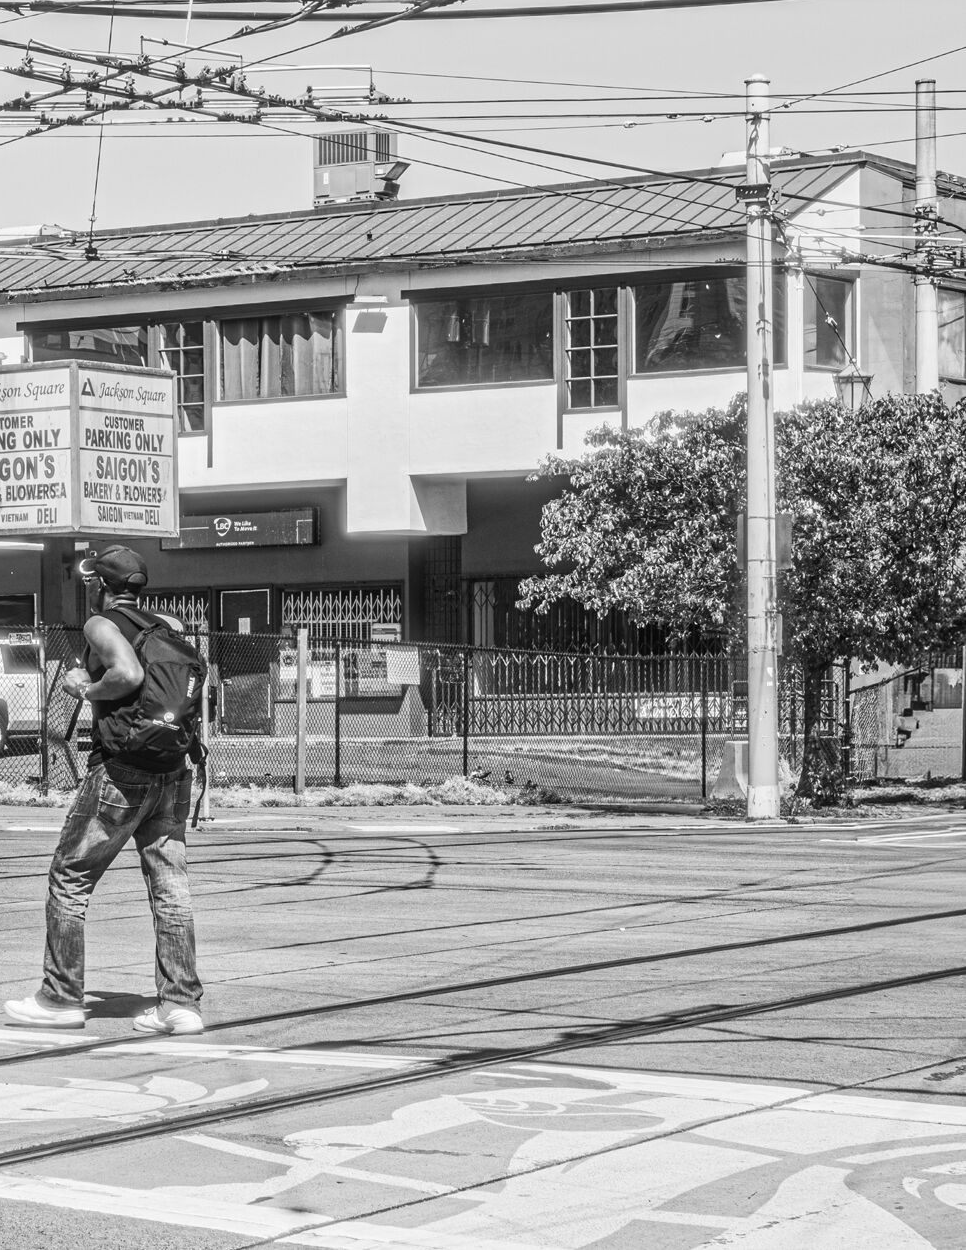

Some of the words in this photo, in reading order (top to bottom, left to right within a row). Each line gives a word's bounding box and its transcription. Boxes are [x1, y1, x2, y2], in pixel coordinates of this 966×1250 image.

[24, 382, 65, 401] Square
[99, 382, 134, 402] Jackson
[136, 386, 166, 405] Square
[104, 415, 145, 432] CUSTOMER
[23, 429, 62, 449] ONLY
[85, 428, 131, 451] PARKING
[135, 433, 164, 452] ONLY
[96, 455, 160, 484] SAIGON'S
[83, 481, 114, 500] BAKERY
[115, 484, 121, 501] &
[123, 485, 162, 503] FLOWERS
[1, 513, 29, 523] VIETNAM
[37, 508, 57, 525] DELI
[97, 505, 123, 523] SAIGON
[123, 511, 144, 521] VIETNAM
[144, 508, 160, 526] DELI
